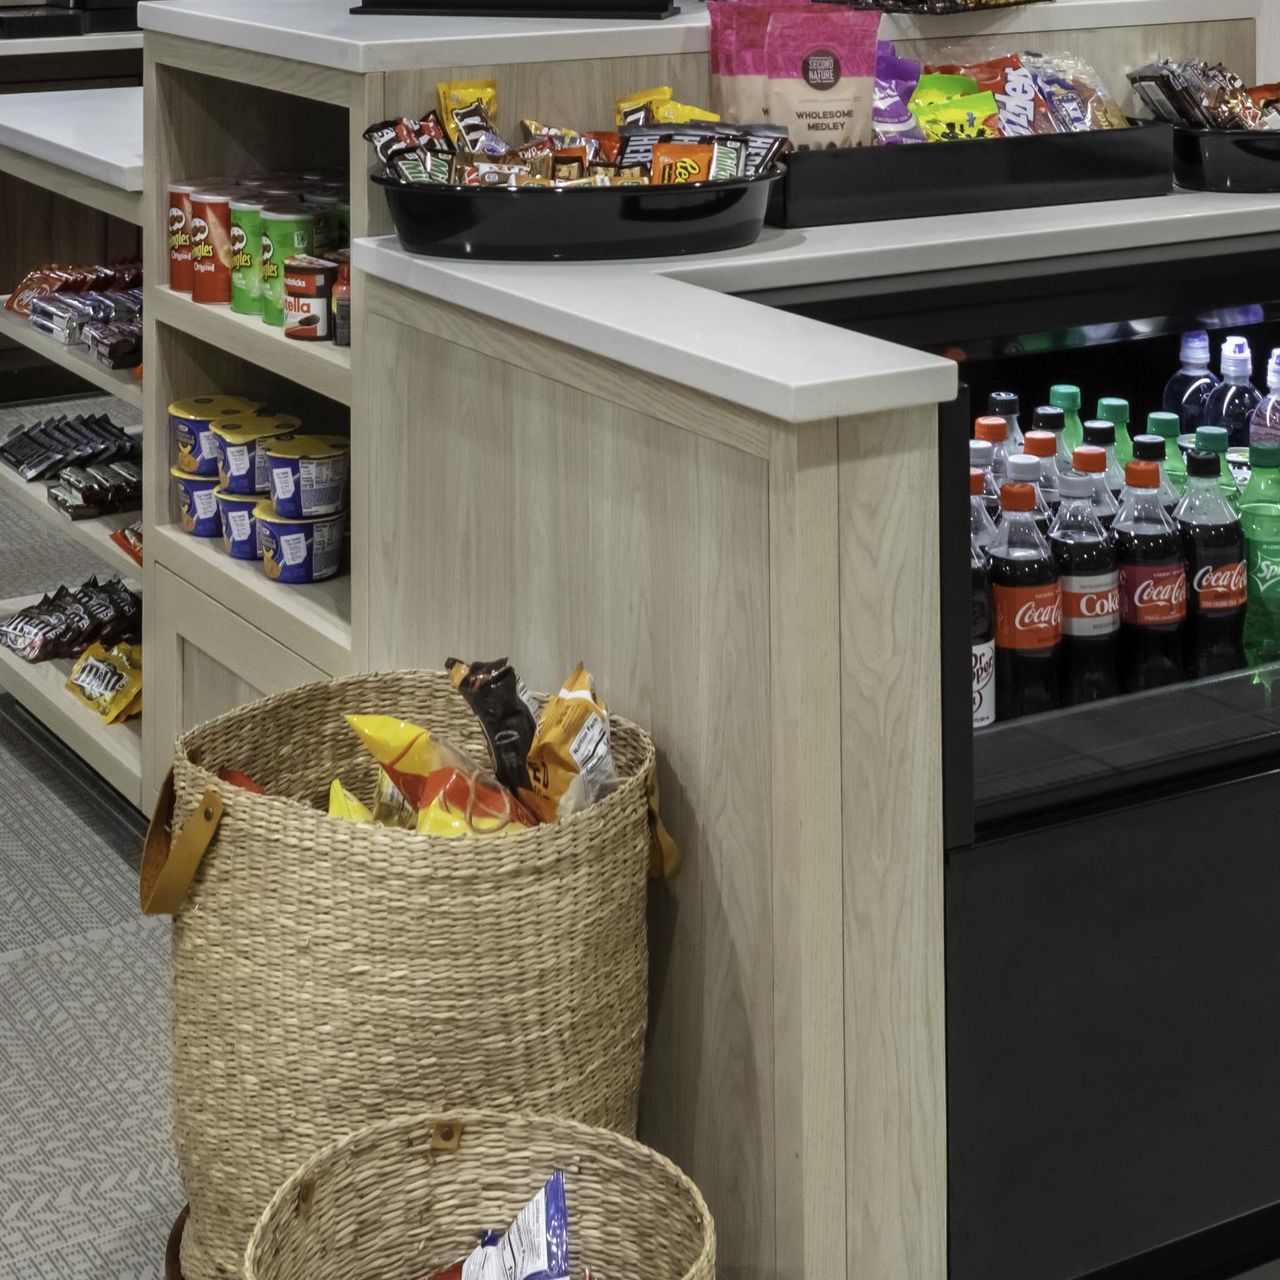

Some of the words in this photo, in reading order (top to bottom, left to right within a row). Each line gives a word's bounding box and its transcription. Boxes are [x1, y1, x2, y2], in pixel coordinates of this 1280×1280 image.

[808, 58, 833, 69] SECOND
[808, 70, 834, 81] NATURE
[795, 110, 854, 120] WHOLESOME
[807, 122, 846, 132] MEDLEY
[194, 262, 215, 272] Original
[284, 297, 311, 314] tella
